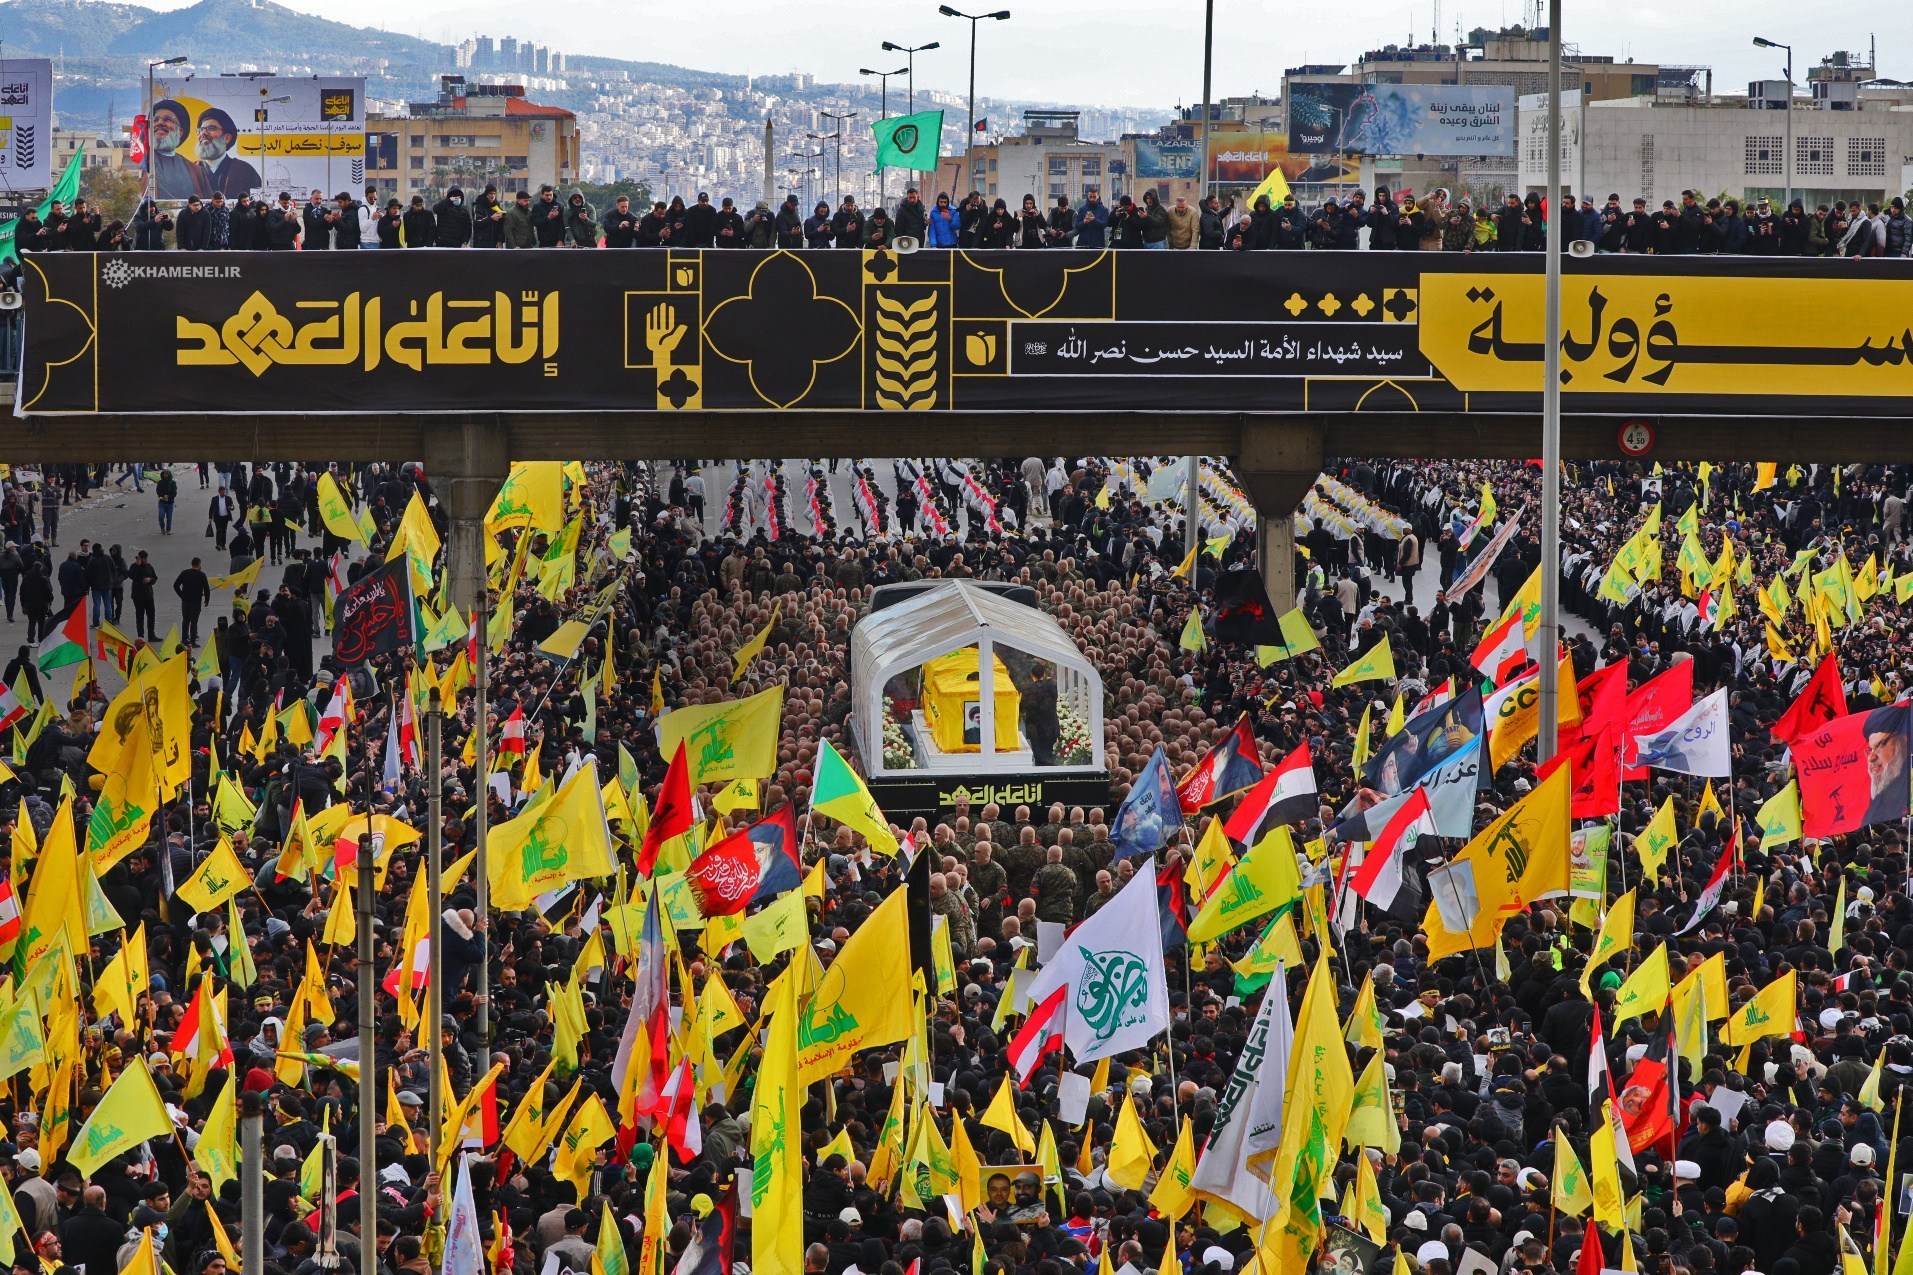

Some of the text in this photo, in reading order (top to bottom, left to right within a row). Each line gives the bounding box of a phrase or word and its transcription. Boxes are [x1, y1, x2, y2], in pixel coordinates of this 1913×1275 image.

[1, 94, 28, 105] العهد
[1430, 102, 1500, 114] لبنان يبقى زينة
[1439, 115, 1500, 127] الشرق وعيده
[241, 137, 362, 154] سوف نكمل الدرب
[1149, 140, 1202, 148] LAZARUS
[176, 290, 381, 378] العهد
[384, 291, 492, 372] على
[1465, 284, 1913, 386] سؤولية
[1057, 328, 1087, 361] الله
[1090, 340, 1128, 364] نصر
[1129, 343, 1200, 363] حسن
[1204, 340, 1254, 365] السيد
[1260, 334, 1300, 361] الأمة
[1306, 343, 1362, 361] شهداء
[1366, 346, 1404, 365] سيد
[1683, 720, 1716, 742] الروح
[939, 784, 996, 806] العهد
[803, 1048, 835, 1066] الإسلامية
[1249, 1122, 1276, 1141] منتظ
